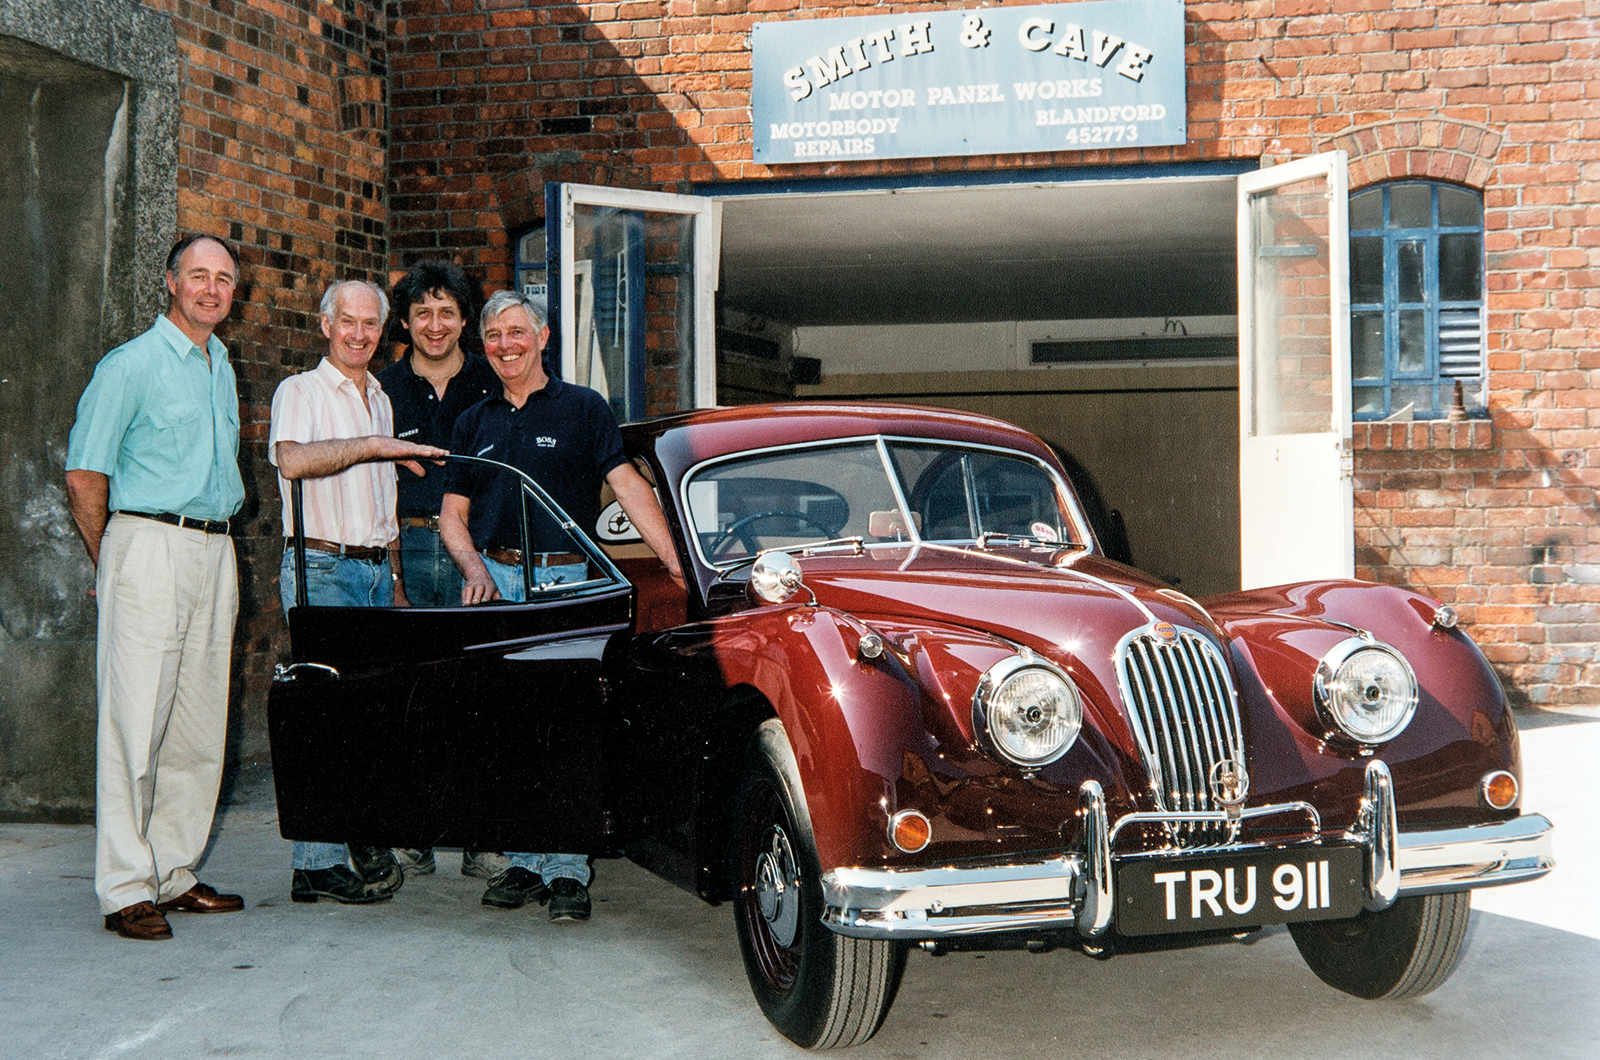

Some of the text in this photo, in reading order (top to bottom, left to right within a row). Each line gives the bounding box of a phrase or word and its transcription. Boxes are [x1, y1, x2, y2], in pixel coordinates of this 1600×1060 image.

[783, 15, 1153, 100] SMITH & CAVE
[829, 78, 1103, 111] MOTOR PANEL WORKS
[1036, 104, 1166, 126] BLANDFORD
[770, 118, 900, 140] MOTORBODY
[1065, 125, 1138, 144] 452773
[794, 138, 875, 157] REPAIRS
[1154, 860, 1330, 920] TRU 911
